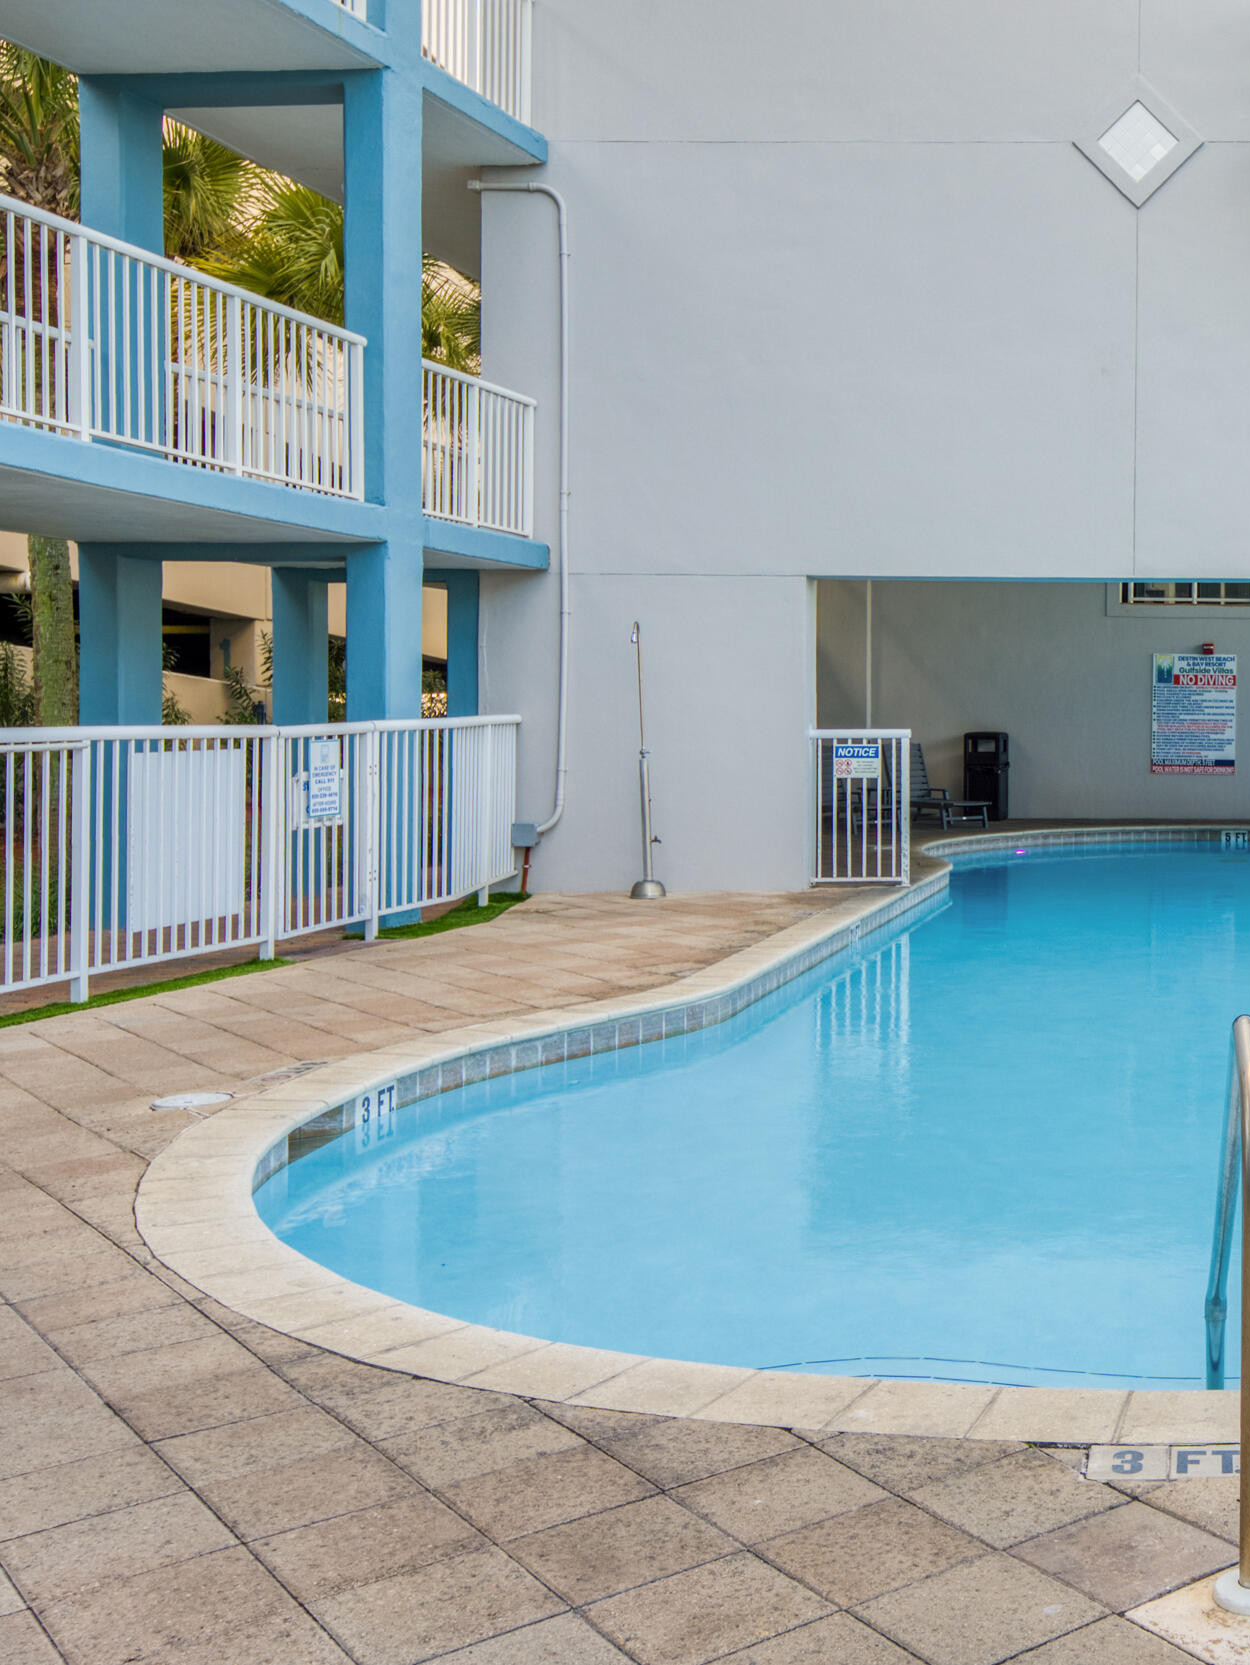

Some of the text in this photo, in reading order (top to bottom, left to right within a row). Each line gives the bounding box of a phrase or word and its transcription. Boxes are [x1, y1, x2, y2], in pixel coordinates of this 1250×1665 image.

[1180, 675, 1234, 686] NO DIVING
[837, 748, 877, 757] NOTICE
[1225, 832, 1231, 842] 5
[362, 1096, 370, 1123] 3
[1111, 1450, 1144, 1475] 3
